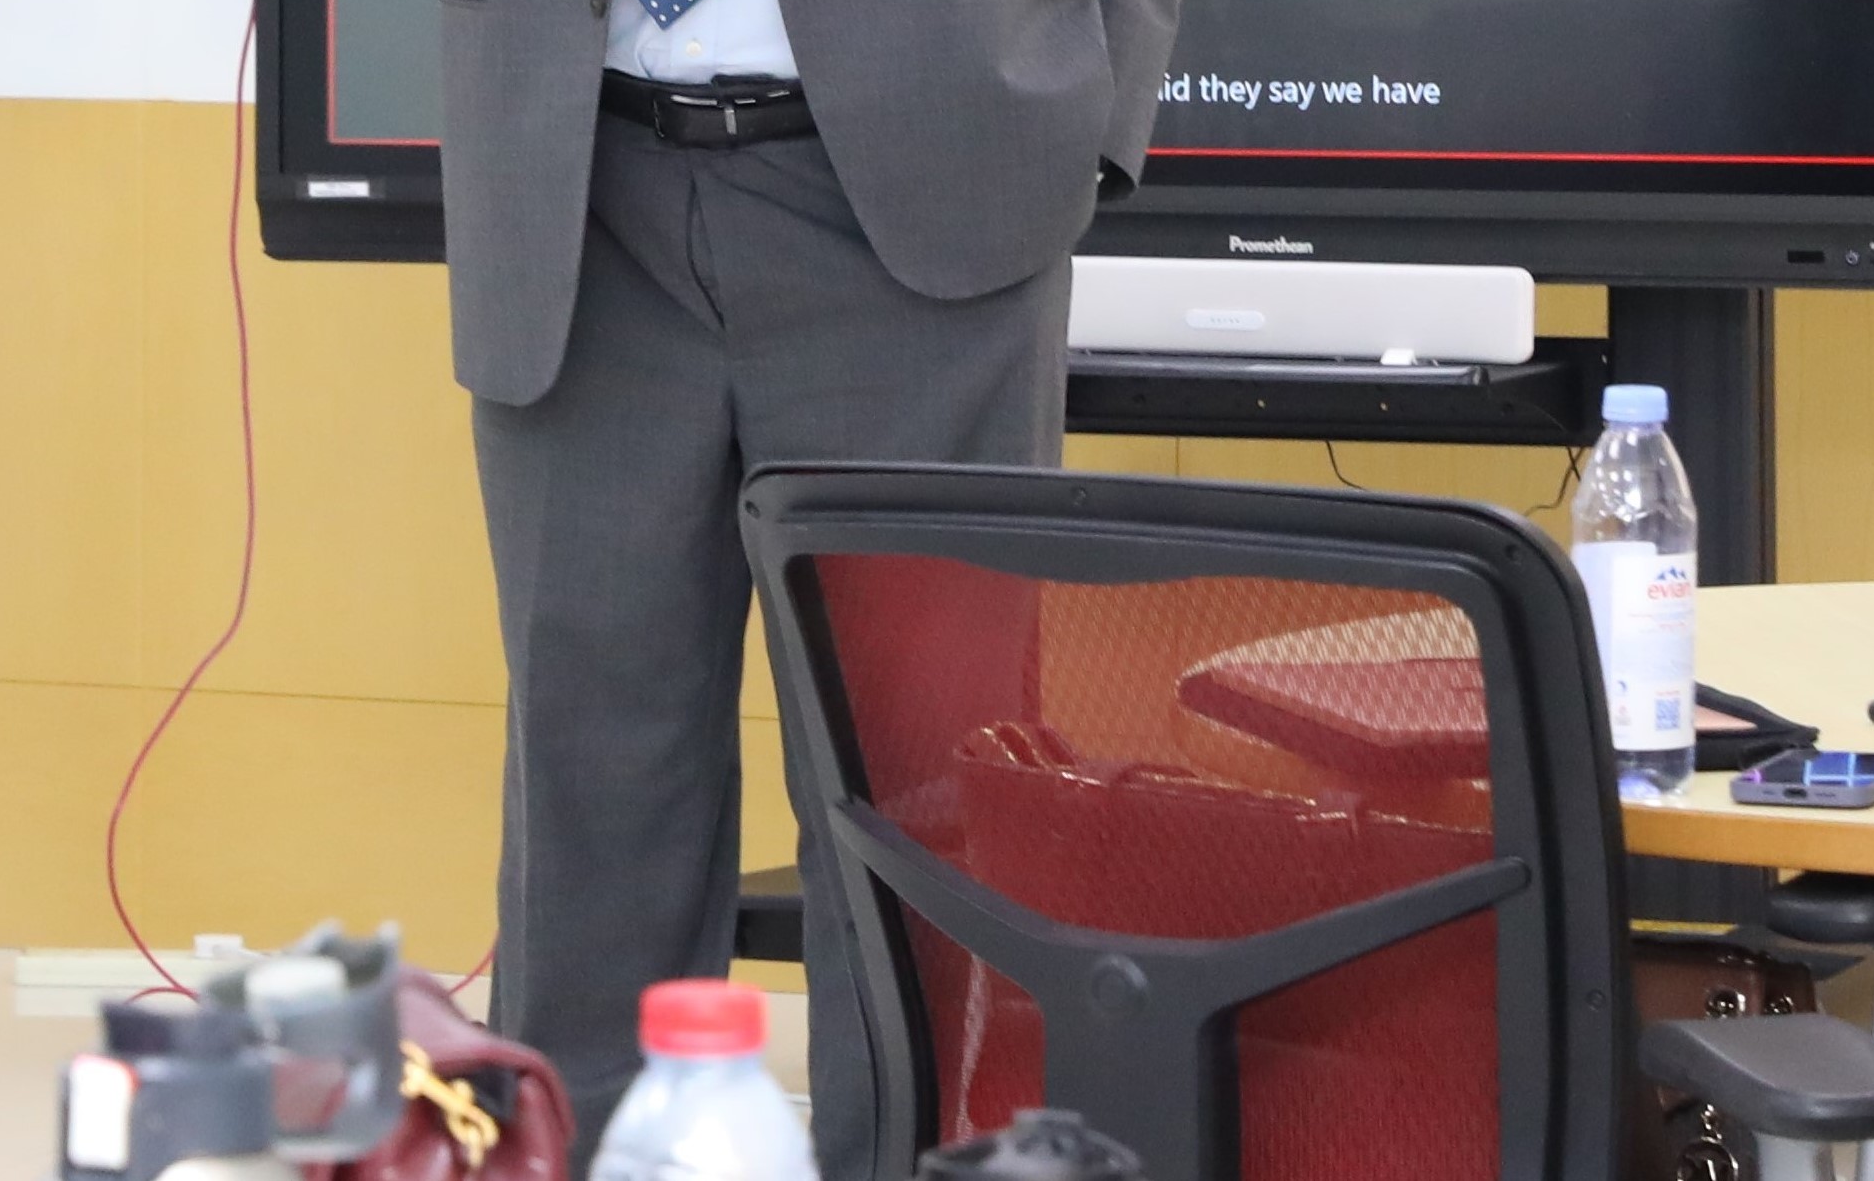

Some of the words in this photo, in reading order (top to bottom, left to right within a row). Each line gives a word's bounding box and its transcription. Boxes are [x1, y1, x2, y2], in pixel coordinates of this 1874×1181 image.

[1157, 72, 1191, 103] id
[1199, 73, 1263, 110] they
[1269, 79, 1316, 110] say
[1321, 80, 1362, 105] we
[1371, 74, 1441, 106] have
[1229, 235, 1314, 255] Promethean
